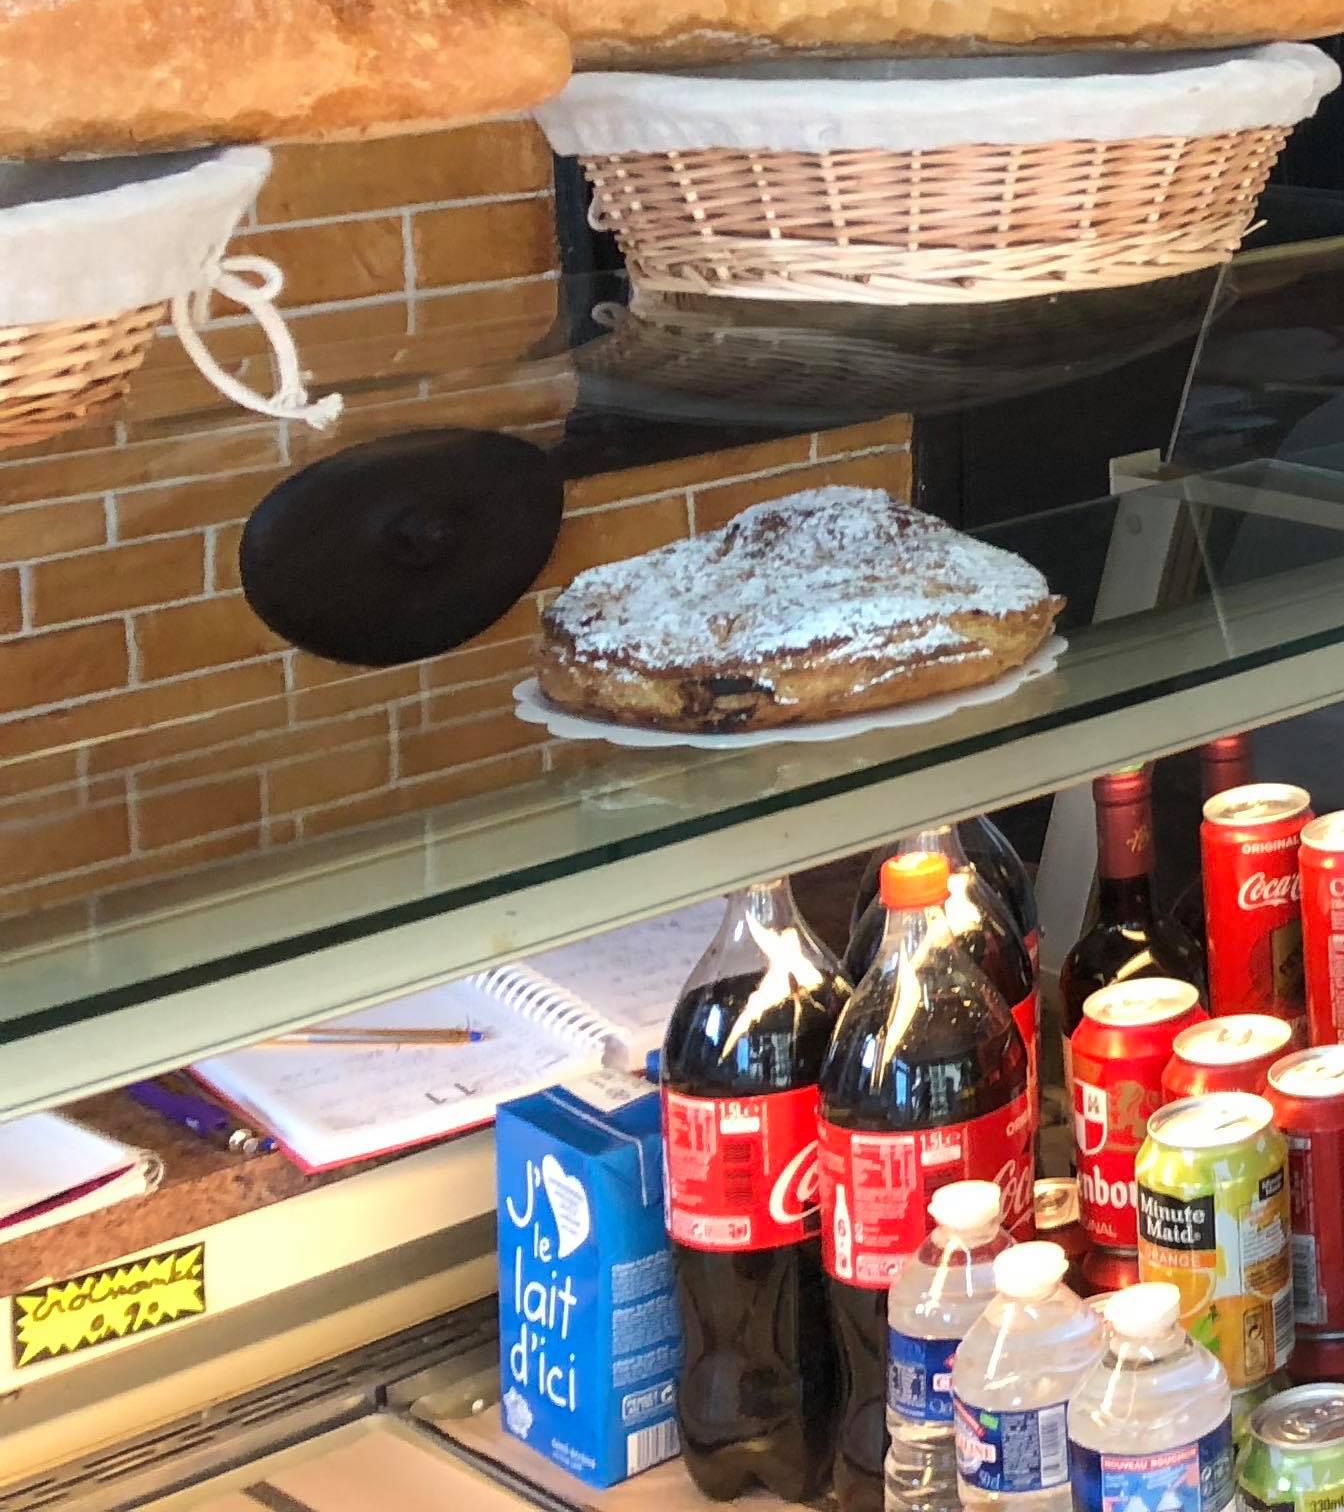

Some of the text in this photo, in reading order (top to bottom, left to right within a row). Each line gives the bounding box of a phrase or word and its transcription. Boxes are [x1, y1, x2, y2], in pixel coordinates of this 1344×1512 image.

[506, 1160, 541, 1228] J'
[1140, 1192, 1206, 1224] Minute
[533, 1222, 552, 1262] le
[1147, 1216, 1193, 1244] Maid
[515, 1246, 577, 1339] lait
[510, 1322, 576, 1413] d'ici
[1104, 1459, 1148, 1471] NOUVEAU
